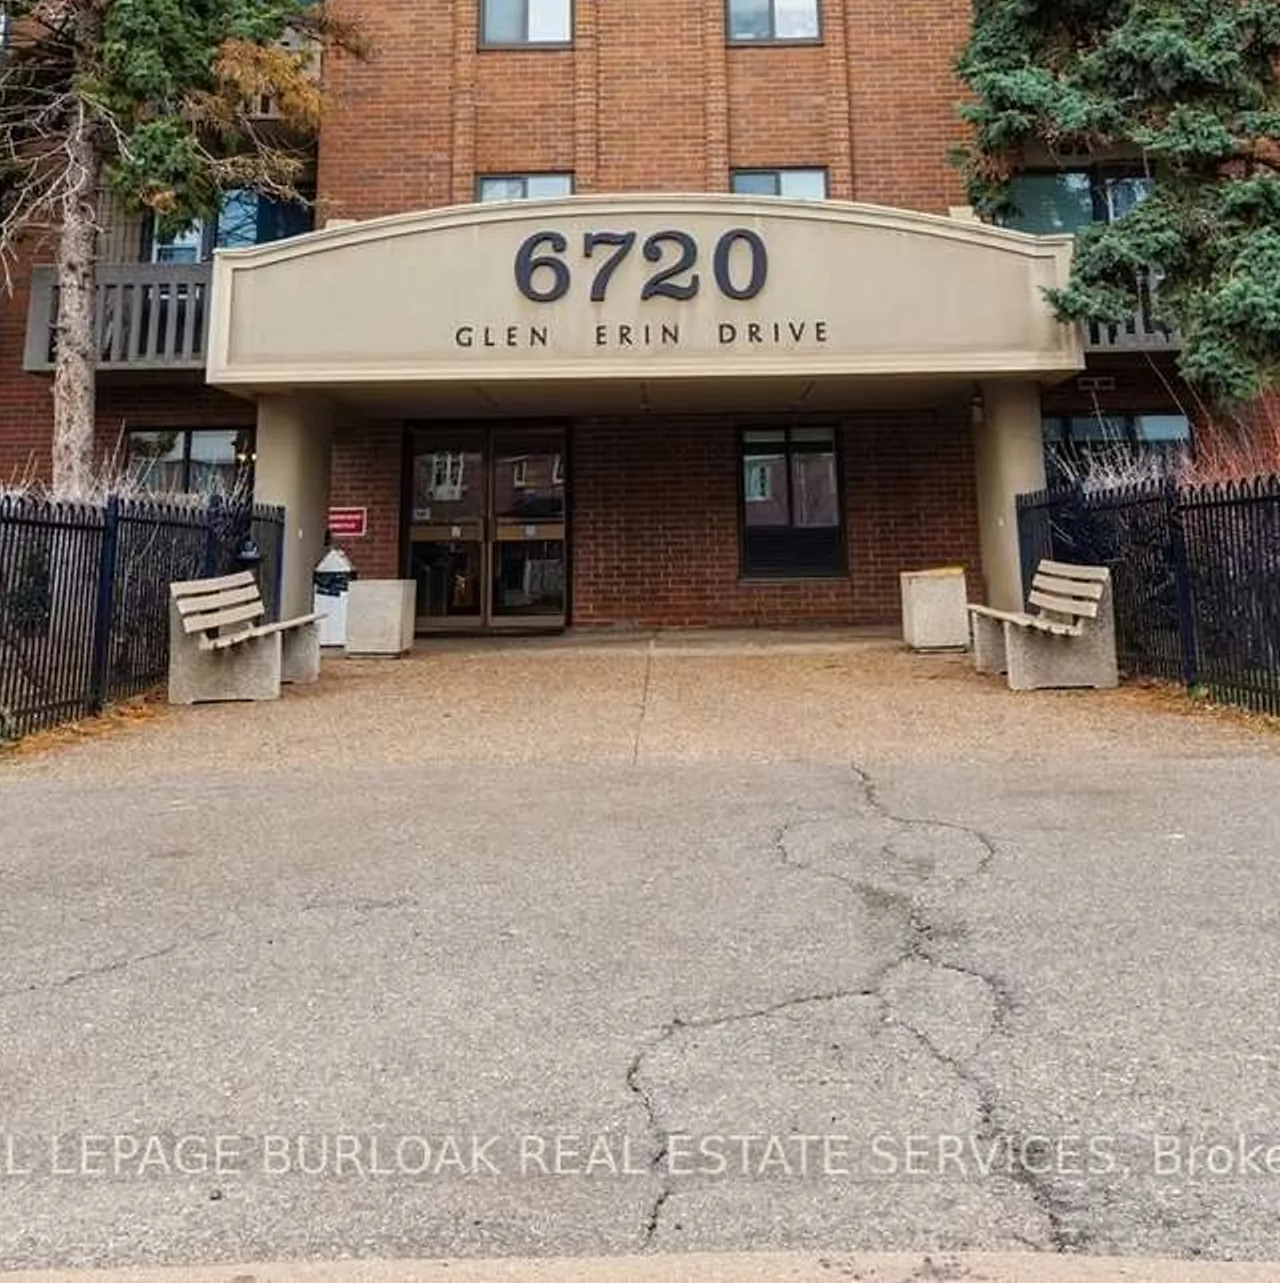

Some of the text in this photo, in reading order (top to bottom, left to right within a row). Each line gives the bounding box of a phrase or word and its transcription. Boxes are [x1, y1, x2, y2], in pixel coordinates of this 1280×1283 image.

[513, 228, 768, 303] 6720
[455, 321, 828, 347] GLEN ERIN DRIVE
